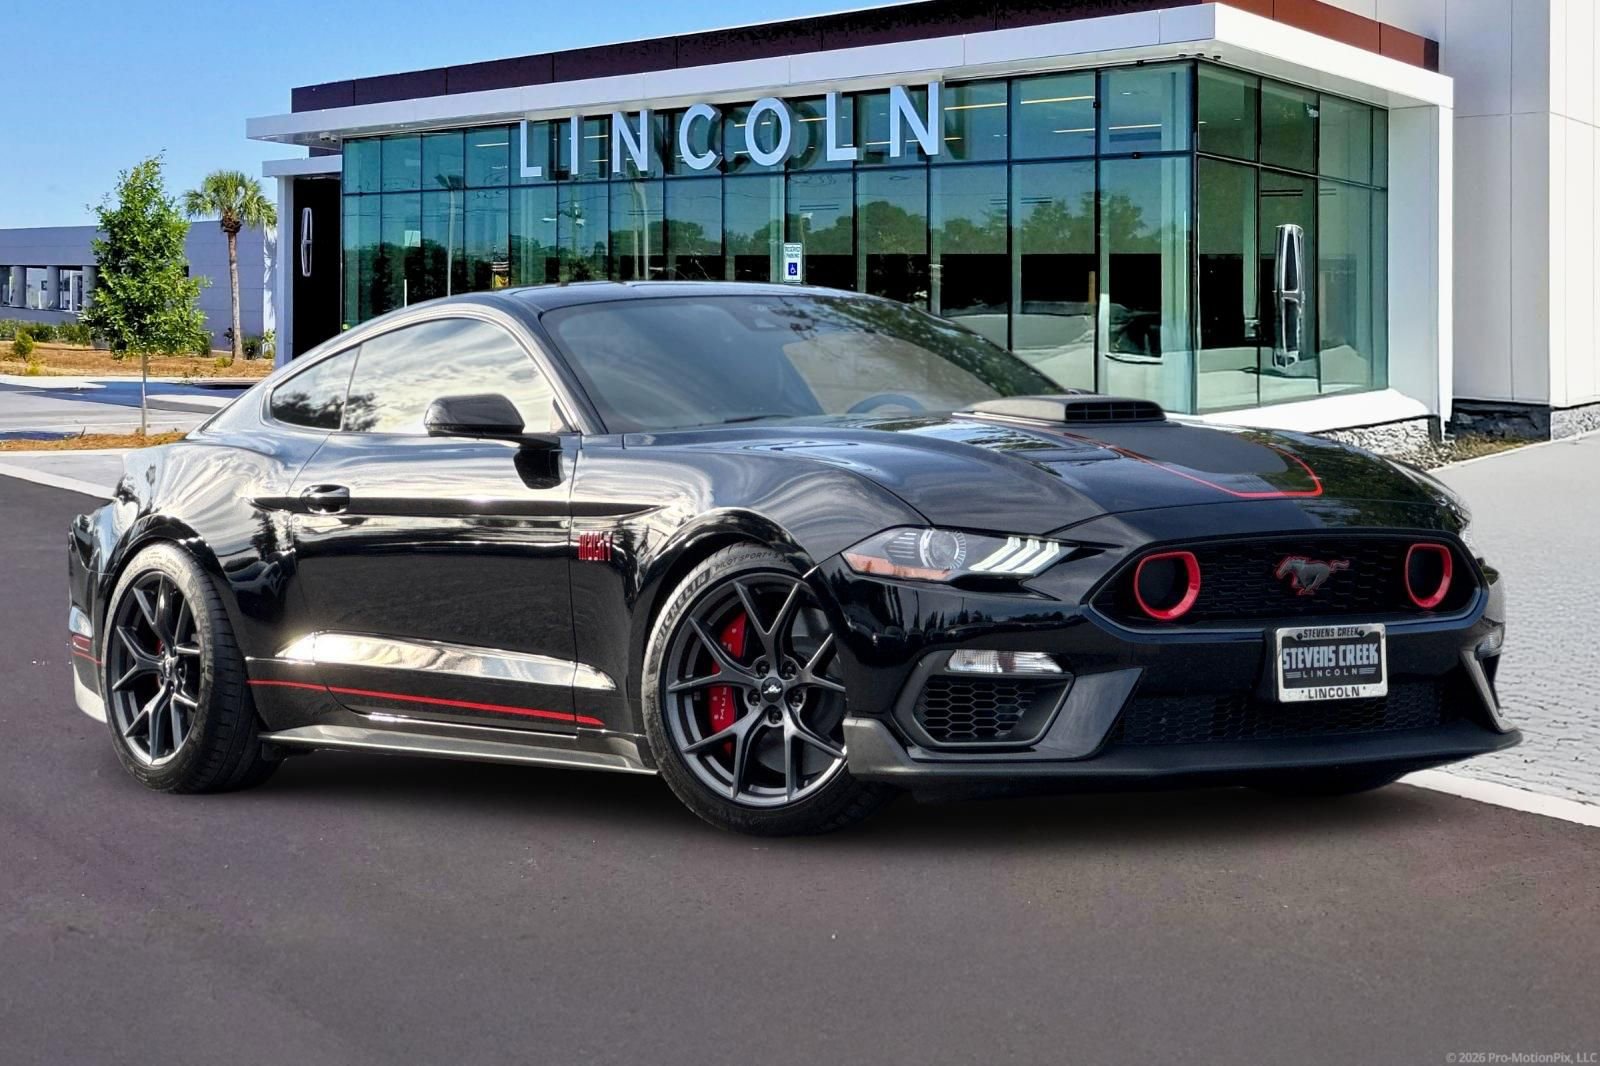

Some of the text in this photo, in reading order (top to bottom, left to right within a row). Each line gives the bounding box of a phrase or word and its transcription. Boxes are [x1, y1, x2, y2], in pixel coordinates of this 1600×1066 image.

[520, 81, 941, 178] LINCOLN
[655, 570, 707, 650] MICHELIN
[1303, 627, 1359, 638] STEVENS CREEK
[1283, 643, 1379, 669] STEVENS CREEK
[1303, 668, 1357, 678] LINCOLN
[1308, 686, 1360, 699] LINCOLN
